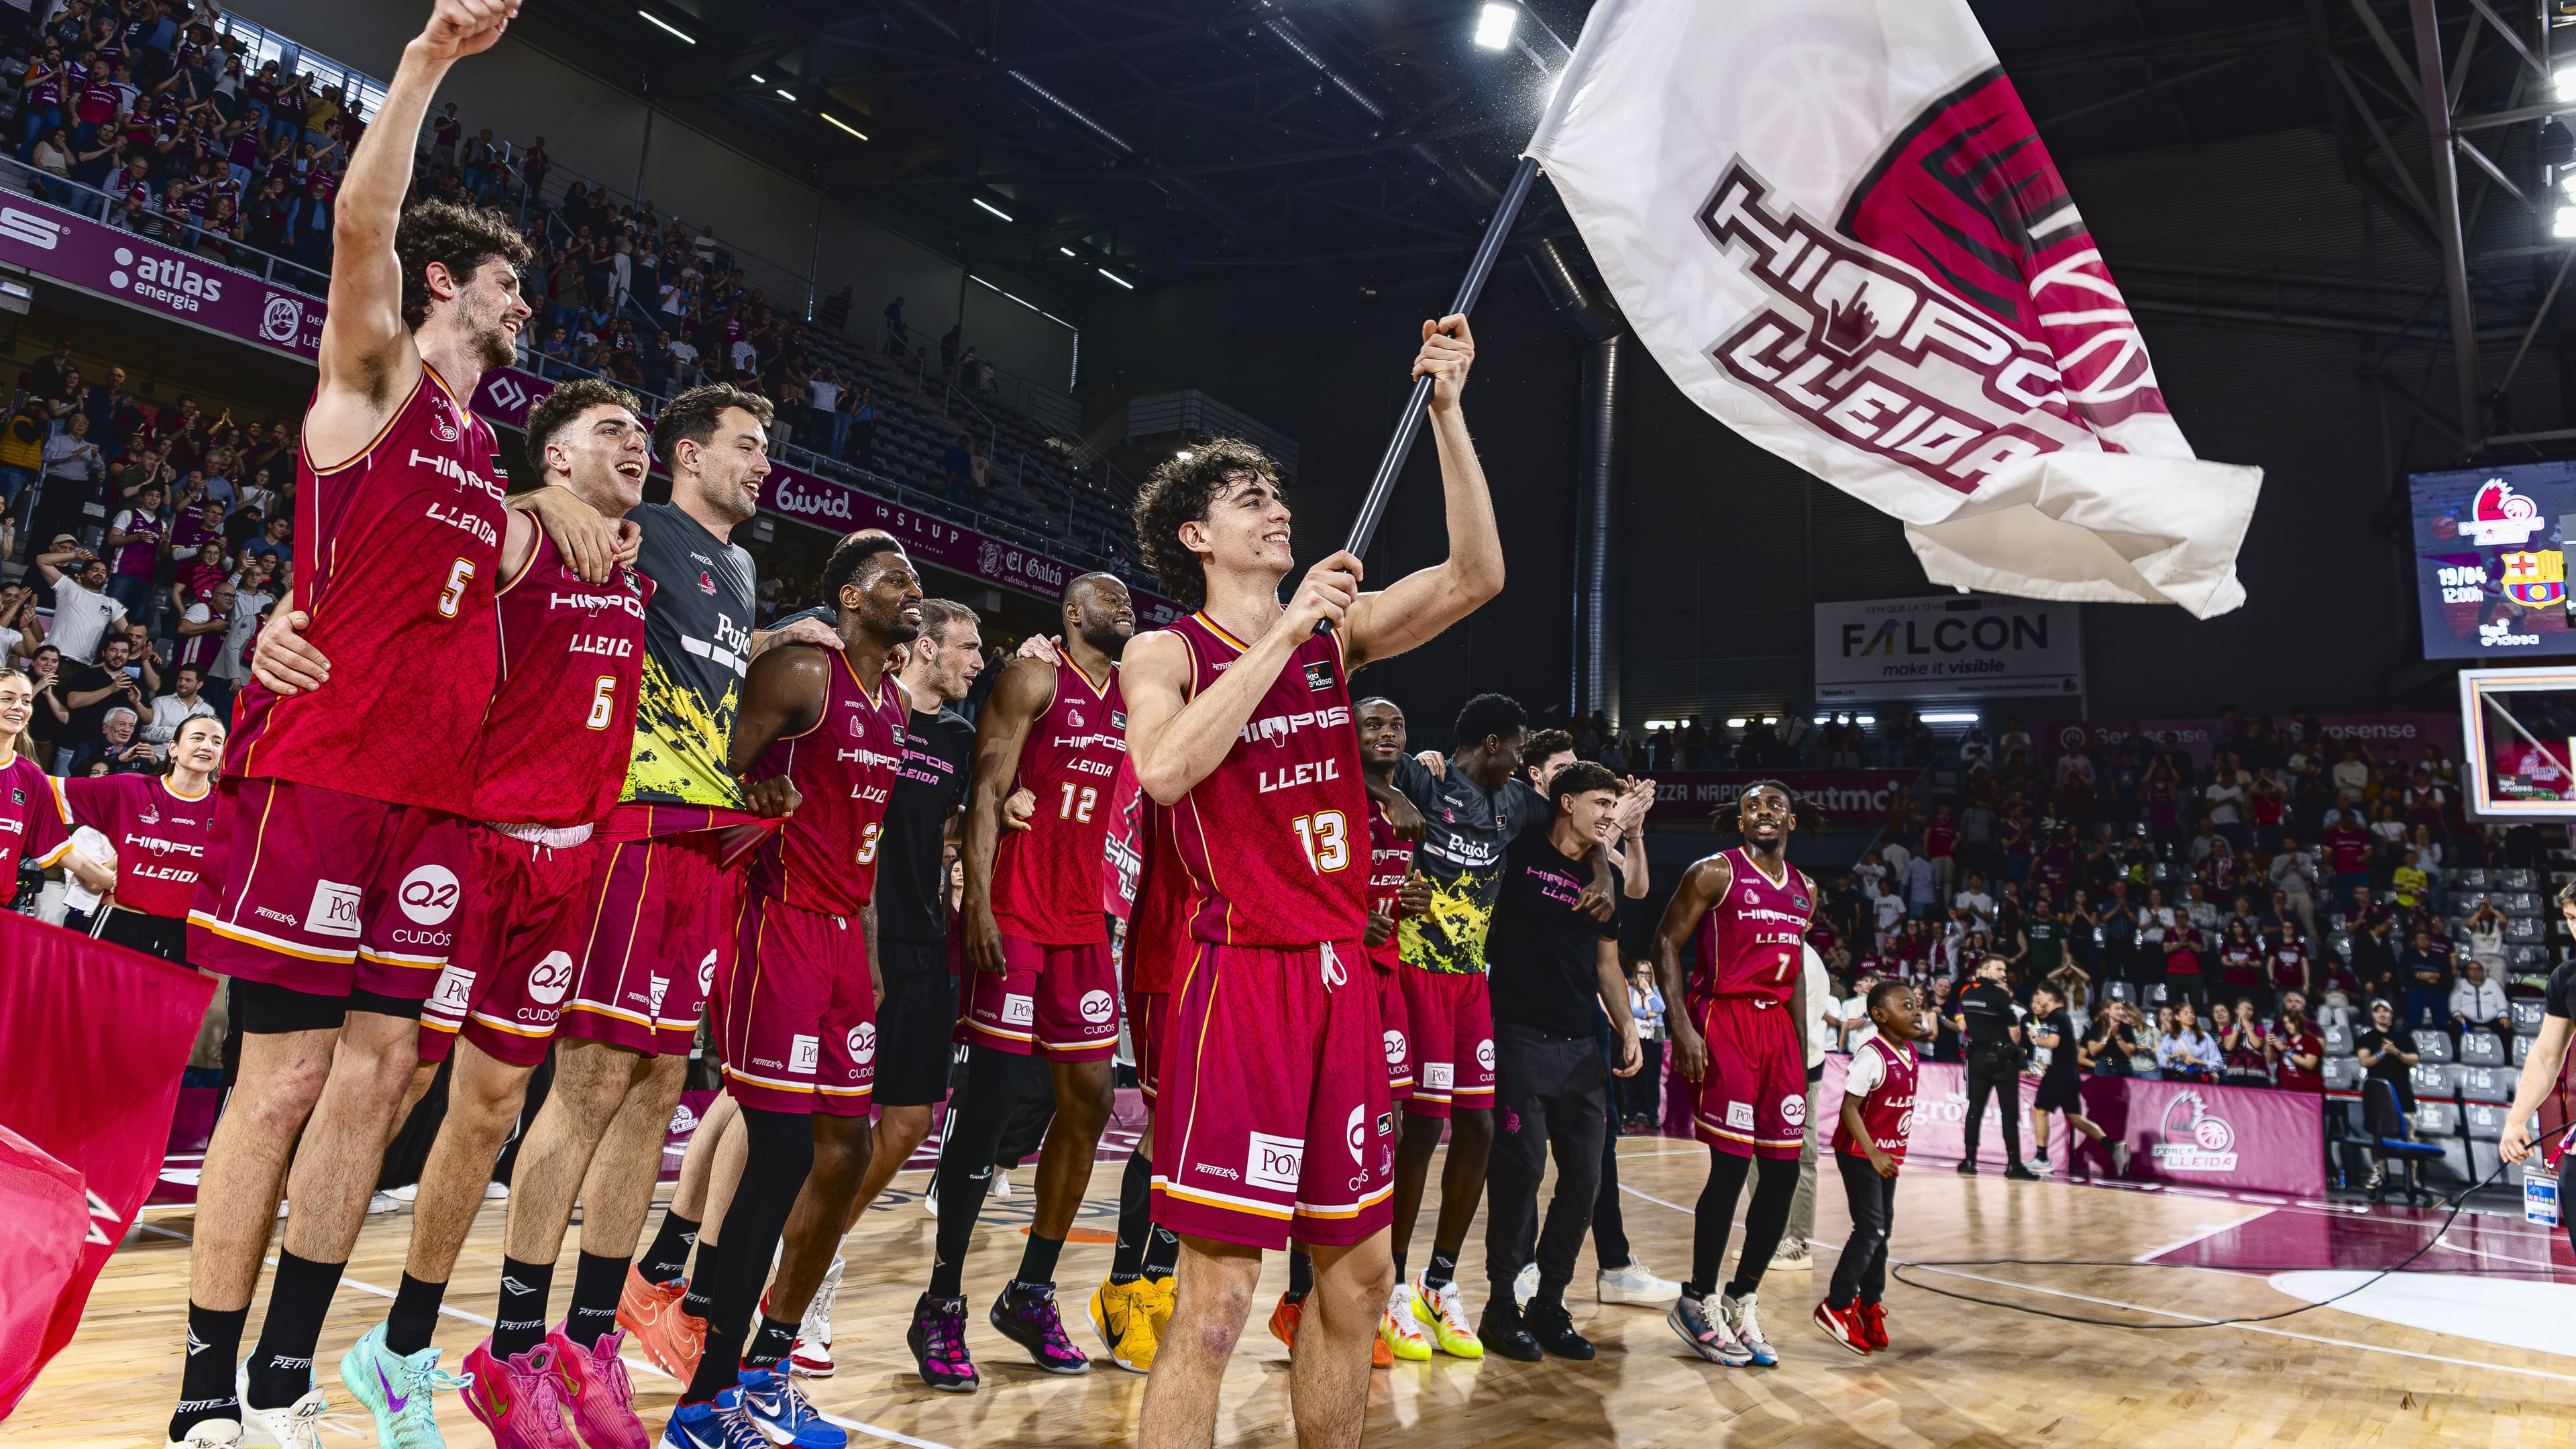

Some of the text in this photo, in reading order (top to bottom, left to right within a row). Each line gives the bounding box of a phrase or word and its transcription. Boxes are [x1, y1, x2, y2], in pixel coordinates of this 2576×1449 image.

[138, 254, 223, 303] atlas
[134, 280, 199, 313] energia
[1727, 323, 2041, 487] LLEIDA
[425, 502, 497, 548] LLEIDA
[1006, 551, 1022, 573] El
[2438, 567, 2487, 586] 19/04
[438, 557, 475, 618] 5
[1032, 584, 1060, 598] restaurant
[2443, 586, 2484, 603] 12:00h
[1843, 613, 2048, 657] FALCON
[2481, 635, 2540, 646] endesa
[1883, 657, 2004, 677] make it visible
[586, 676, 617, 731] 6
[897, 766, 939, 786] LEIDA
[1656, 784, 1688, 801] ZZA
[1060, 782, 1097, 824] 12
[856, 822, 877, 865] 3
[1293, 809, 1350, 875] 13
[1448, 833, 1490, 859] Pujol
[1370, 875, 1405, 885] LEIDA
[402, 880, 458, 910] Q2
[255, 906, 285, 923] PENTEX
[392, 928, 451, 947] CUDÓS
[532, 963, 571, 991] Q2
[1775, 953, 1791, 981] 7
[1083, 998, 1112, 1016] Q2
[849, 1032, 875, 1052] Q2
[752, 1057, 775, 1067] PENTEX
[1389, 1065, 1409, 1075] UDÓS
[1783, 1103, 1805, 1116] Q2
[672, 1120, 699, 1132] LLEIDA
[1379, 1122, 1389, 1133] acb
[1195, 1163, 1228, 1178] PENTEX
[1262, 1148, 1300, 1176] PON
[2169, 1157, 2232, 1167] LLEIDA
